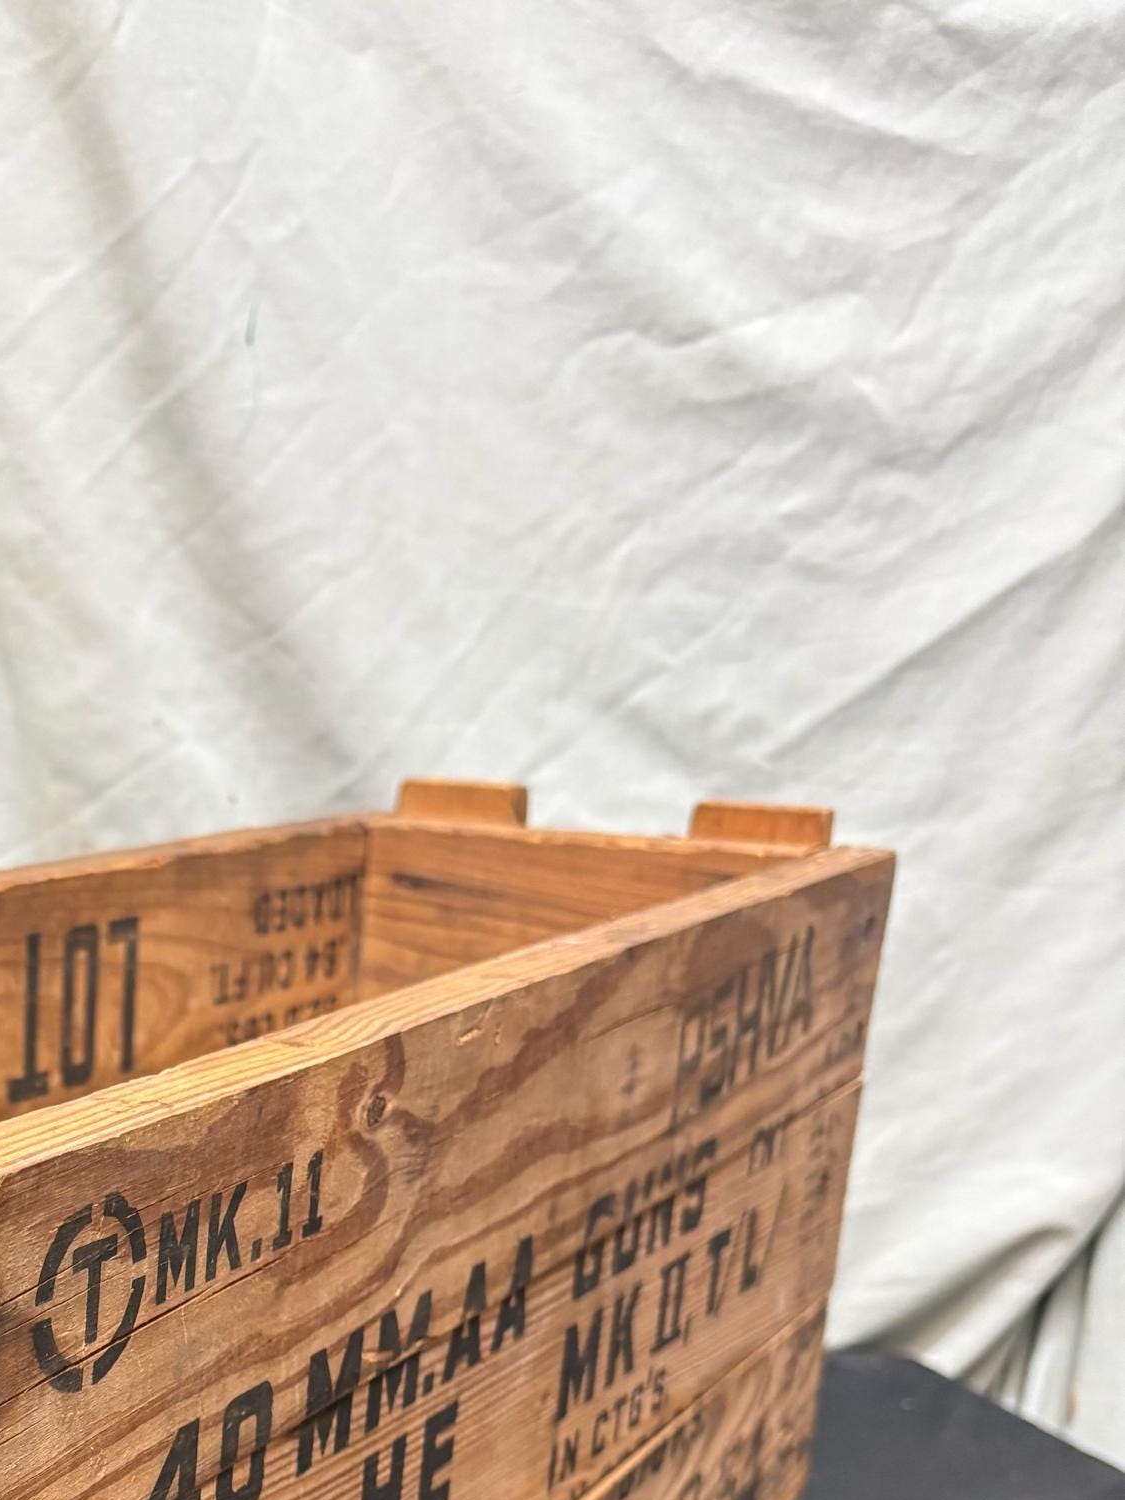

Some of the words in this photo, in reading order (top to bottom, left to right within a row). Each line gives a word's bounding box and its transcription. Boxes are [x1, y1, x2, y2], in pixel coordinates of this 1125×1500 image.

[6, 916, 141, 1104] LOT
[155, 1149, 326, 1307] MK.11
[571, 1137, 719, 1300] GUNS
[556, 1280, 642, 1424] MK
[546, 1428, 579, 1491] IN
